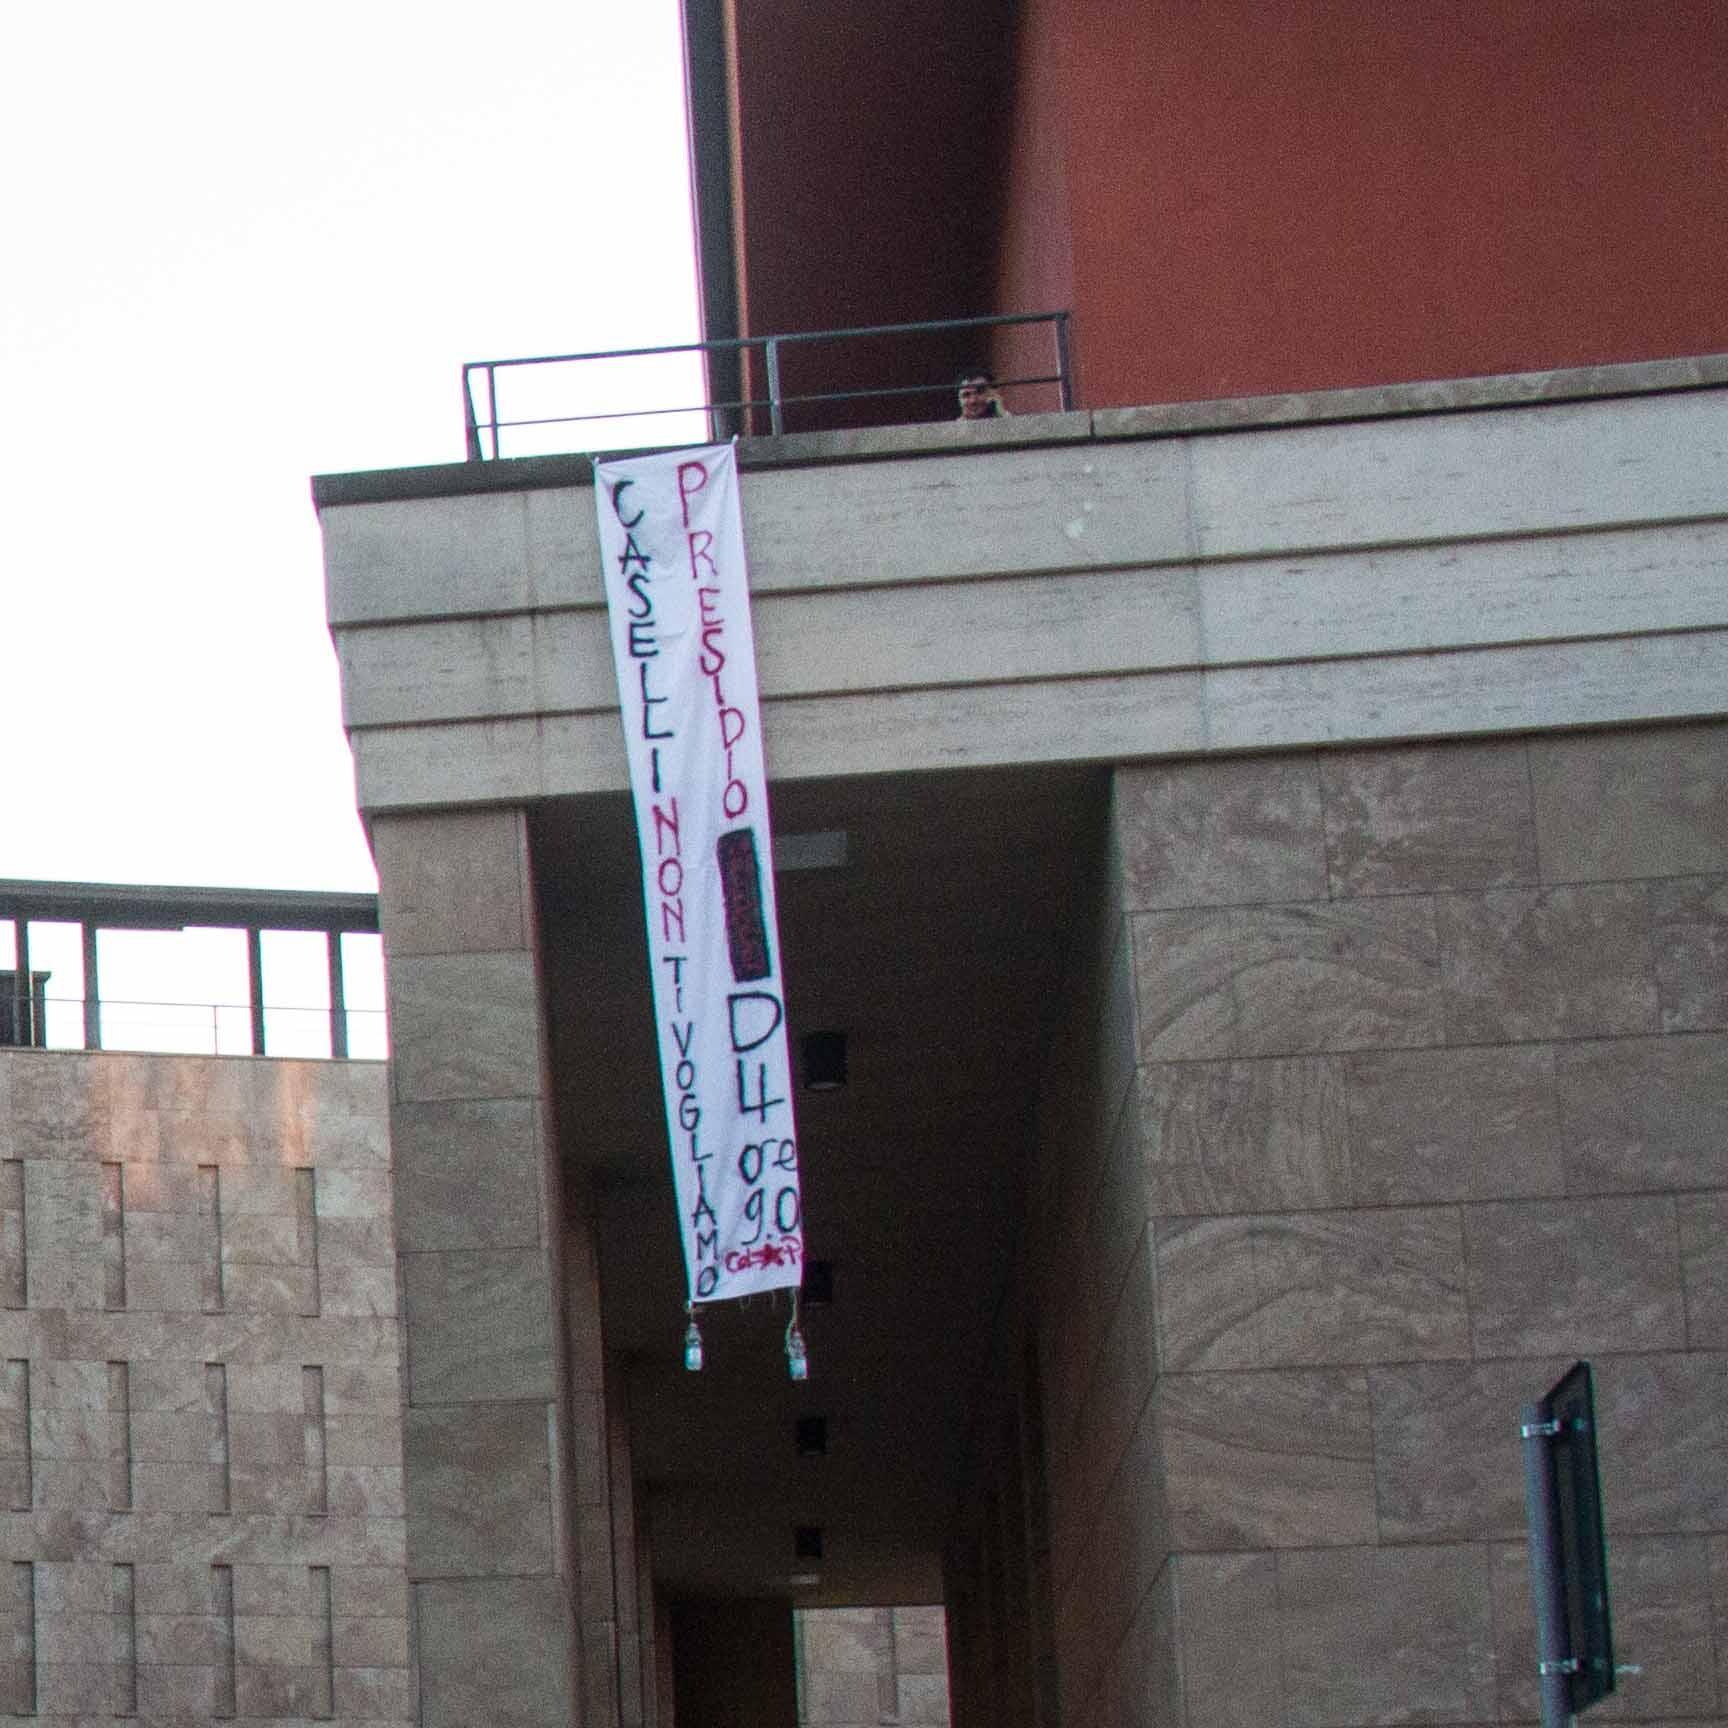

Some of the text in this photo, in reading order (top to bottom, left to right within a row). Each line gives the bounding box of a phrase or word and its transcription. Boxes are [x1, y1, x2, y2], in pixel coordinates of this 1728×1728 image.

[611, 479, 674, 794] CASELLI
[652, 797, 686, 943] NON
[671, 1020, 719, 1298] VOGLIAMO
[676, 461, 747, 819] PRESIDIO
